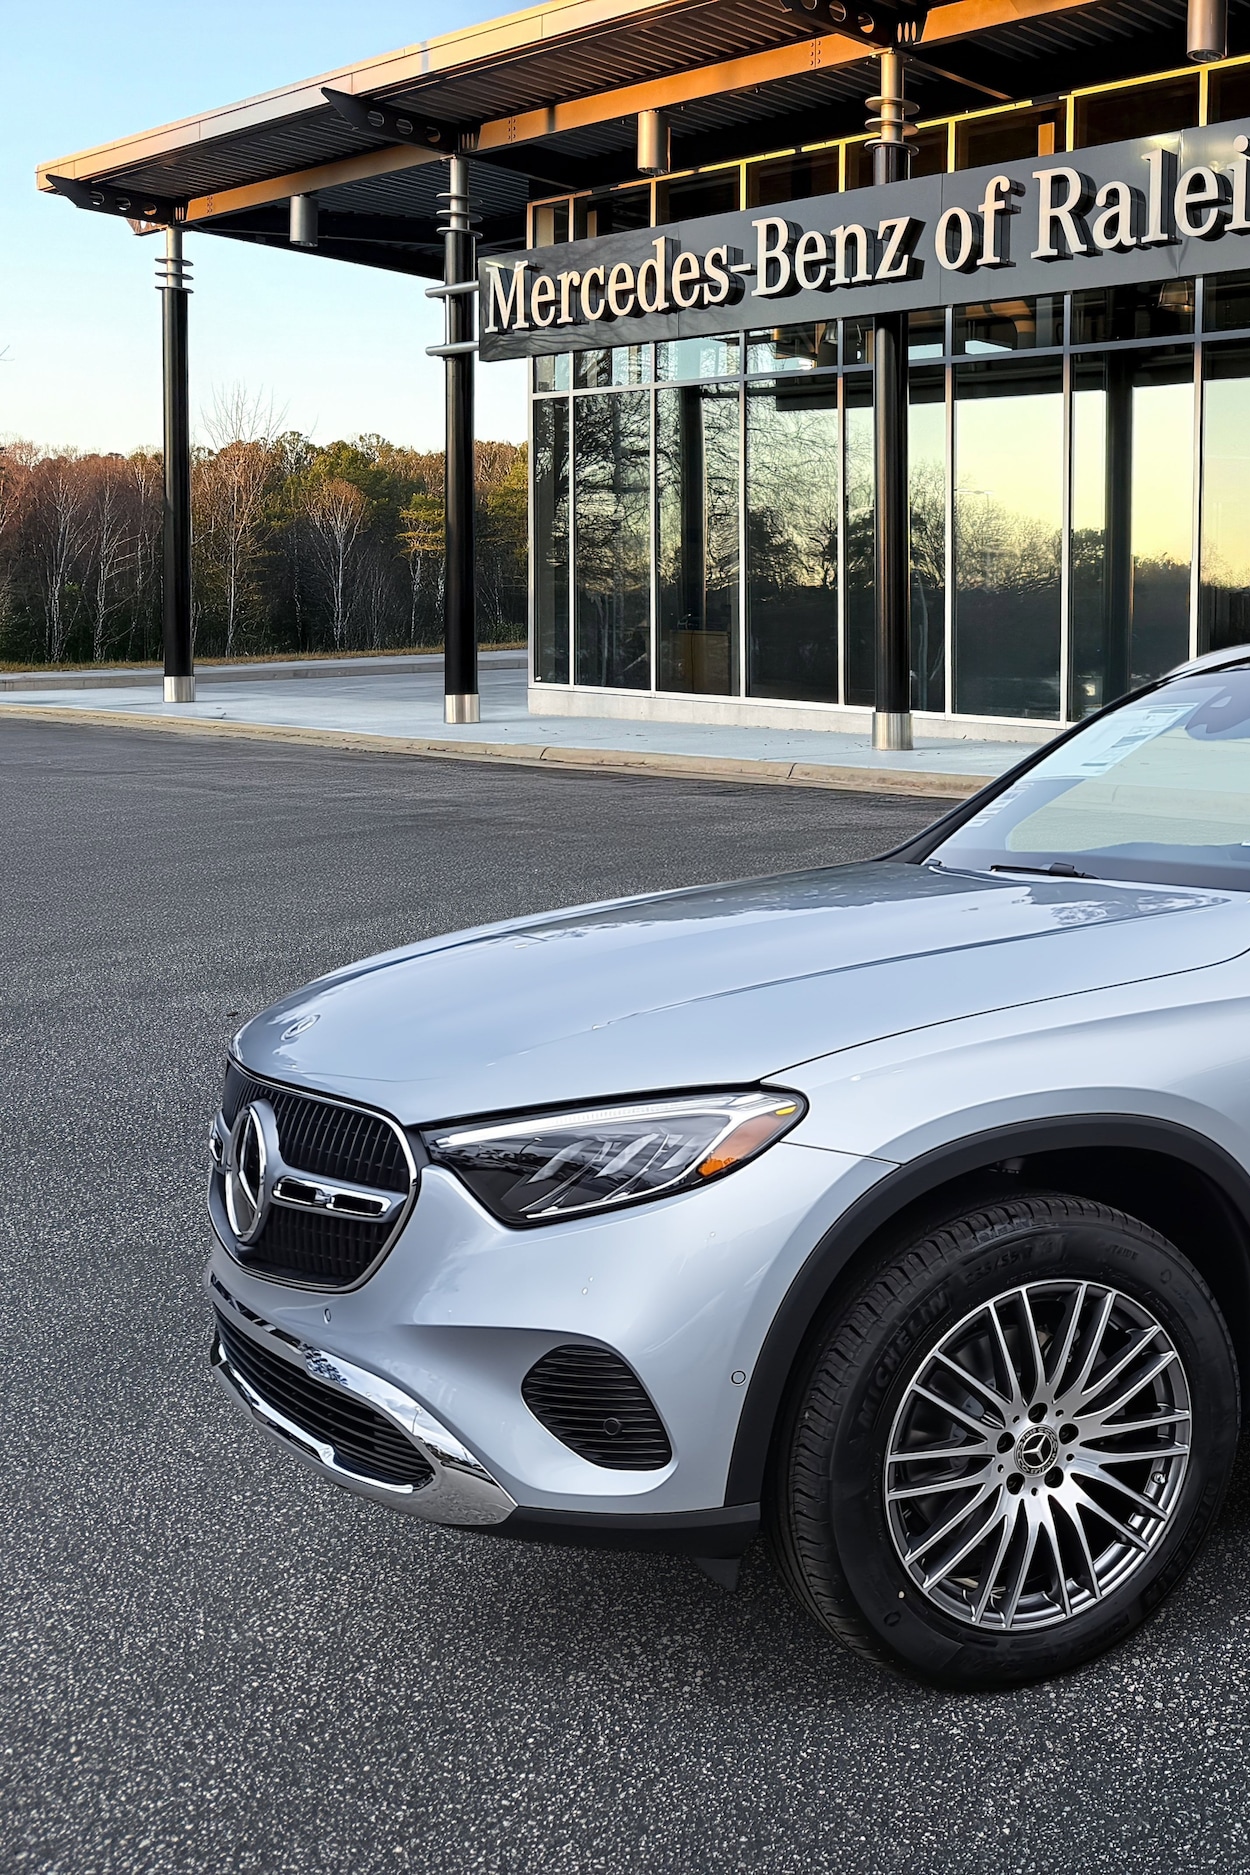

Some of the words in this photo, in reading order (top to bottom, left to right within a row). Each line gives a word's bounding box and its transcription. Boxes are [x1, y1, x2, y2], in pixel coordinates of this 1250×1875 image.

[485, 215, 915, 335] Mercedes-Benz
[935, 176, 1019, 272] of
[857, 1287, 952, 1430] MICHELIN
